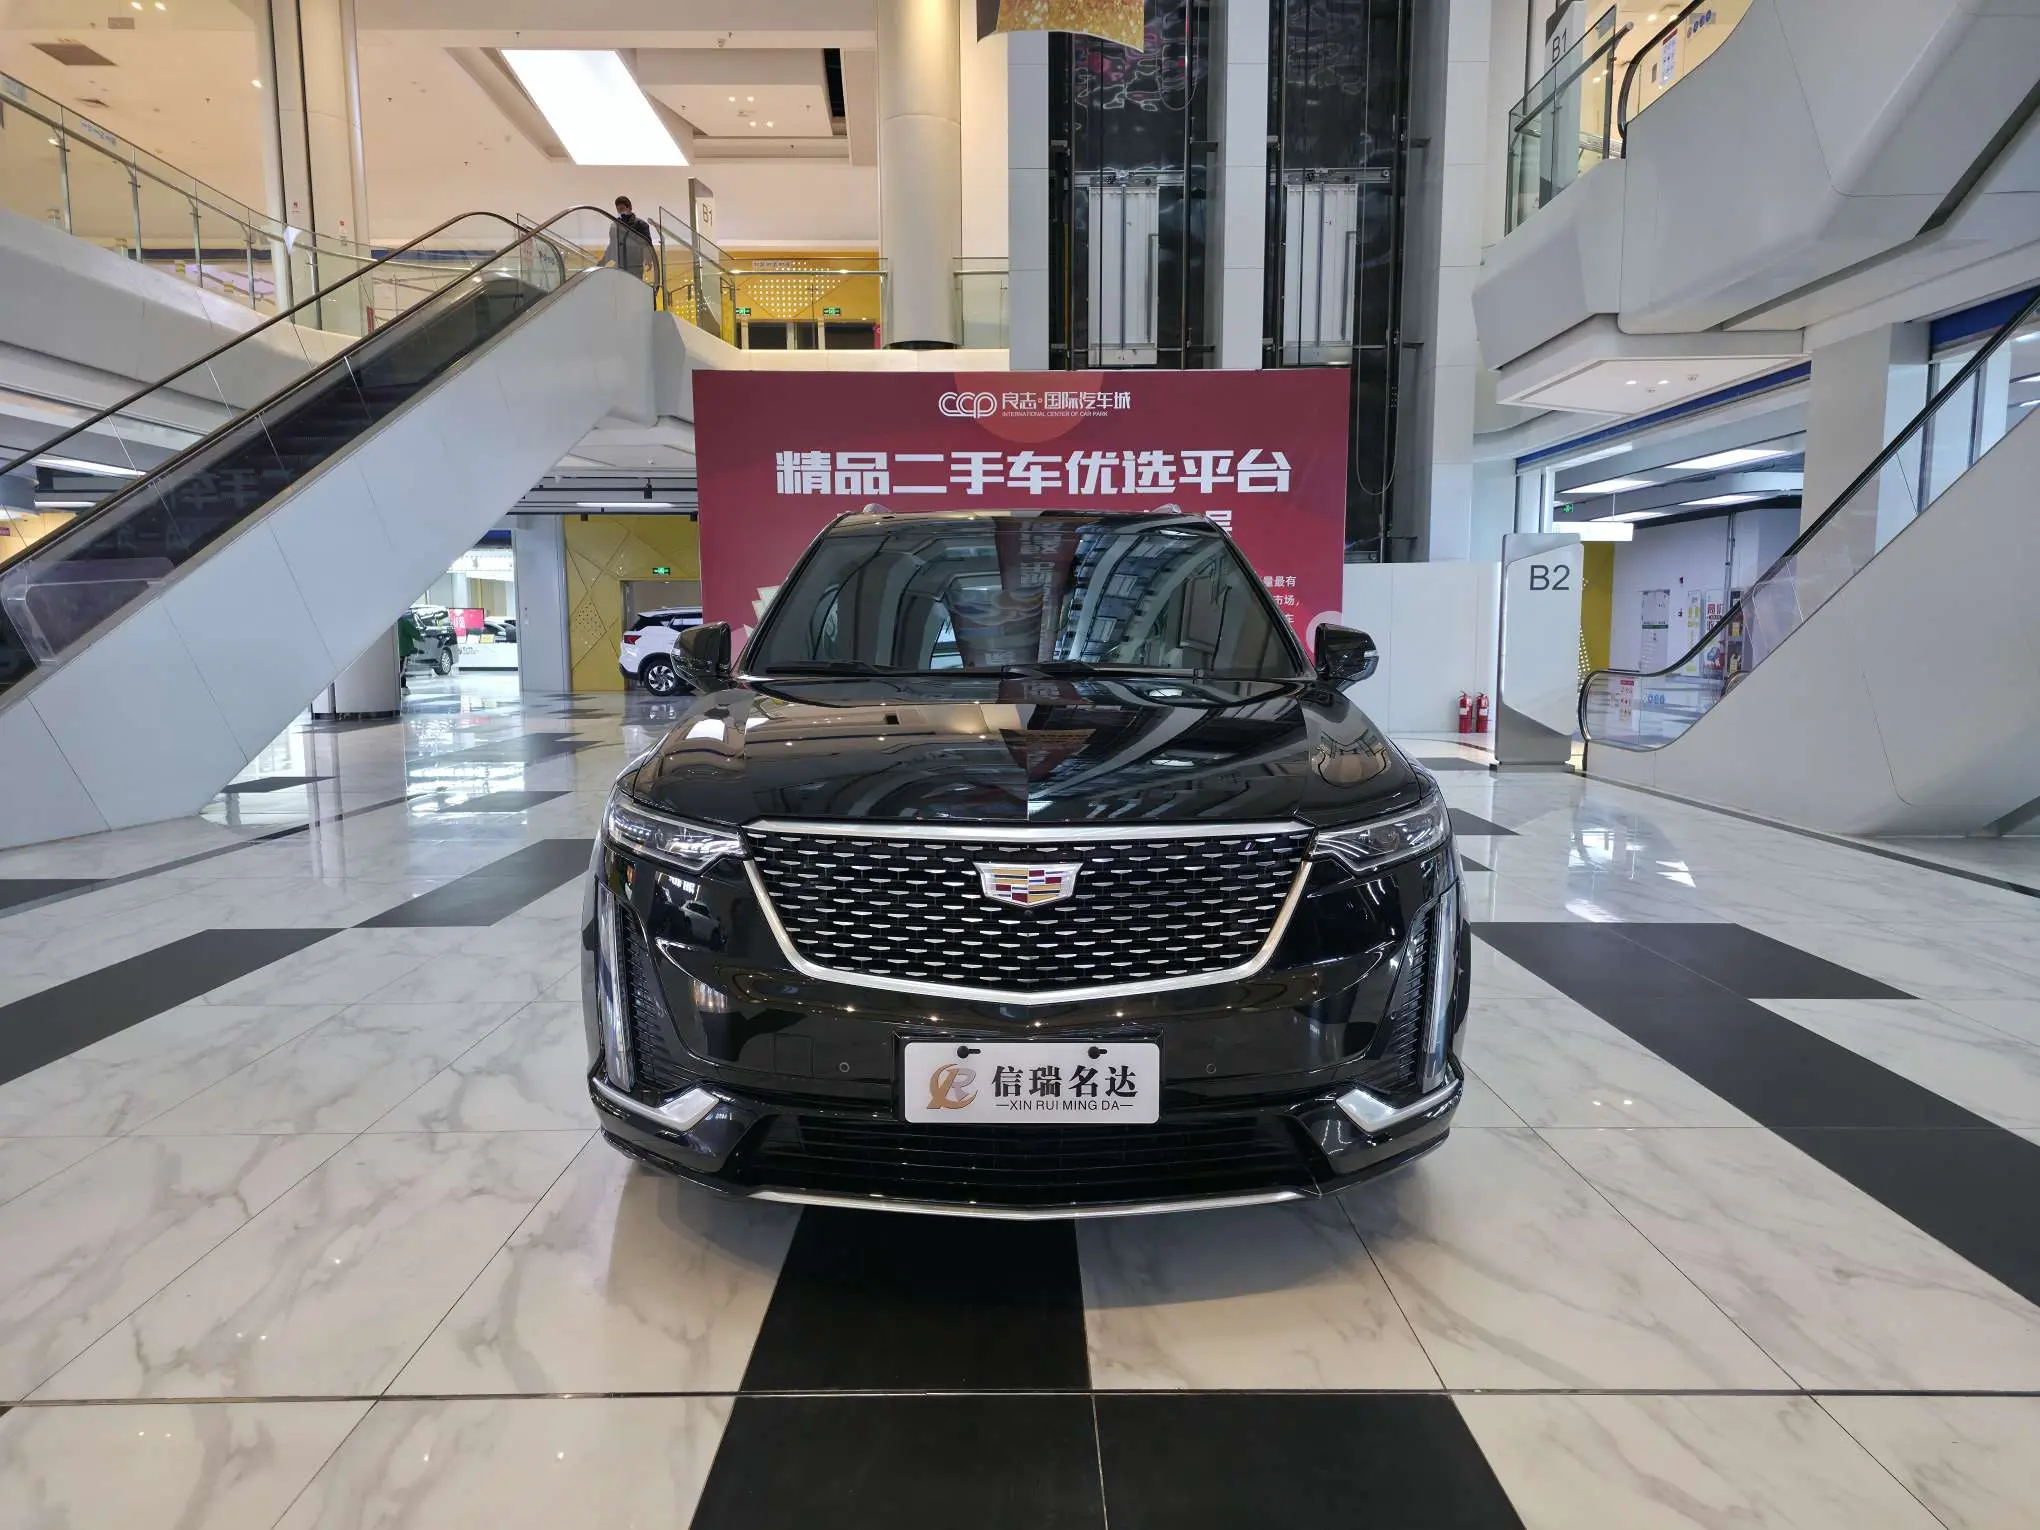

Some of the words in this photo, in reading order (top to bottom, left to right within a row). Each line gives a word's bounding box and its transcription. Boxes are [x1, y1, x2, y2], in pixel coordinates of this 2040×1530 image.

[1552, 28, 1567, 63] B1
[702, 203, 713, 227] B1
[776, 449, 1292, 495] 精品二手车优选平台
[1529, 564, 1570, 591] B2
[992, 1065, 1138, 1098] 信瑞名达
[1036, 1100, 1059, 1111] RUI
[1062, 1100, 1098, 1111] MING
